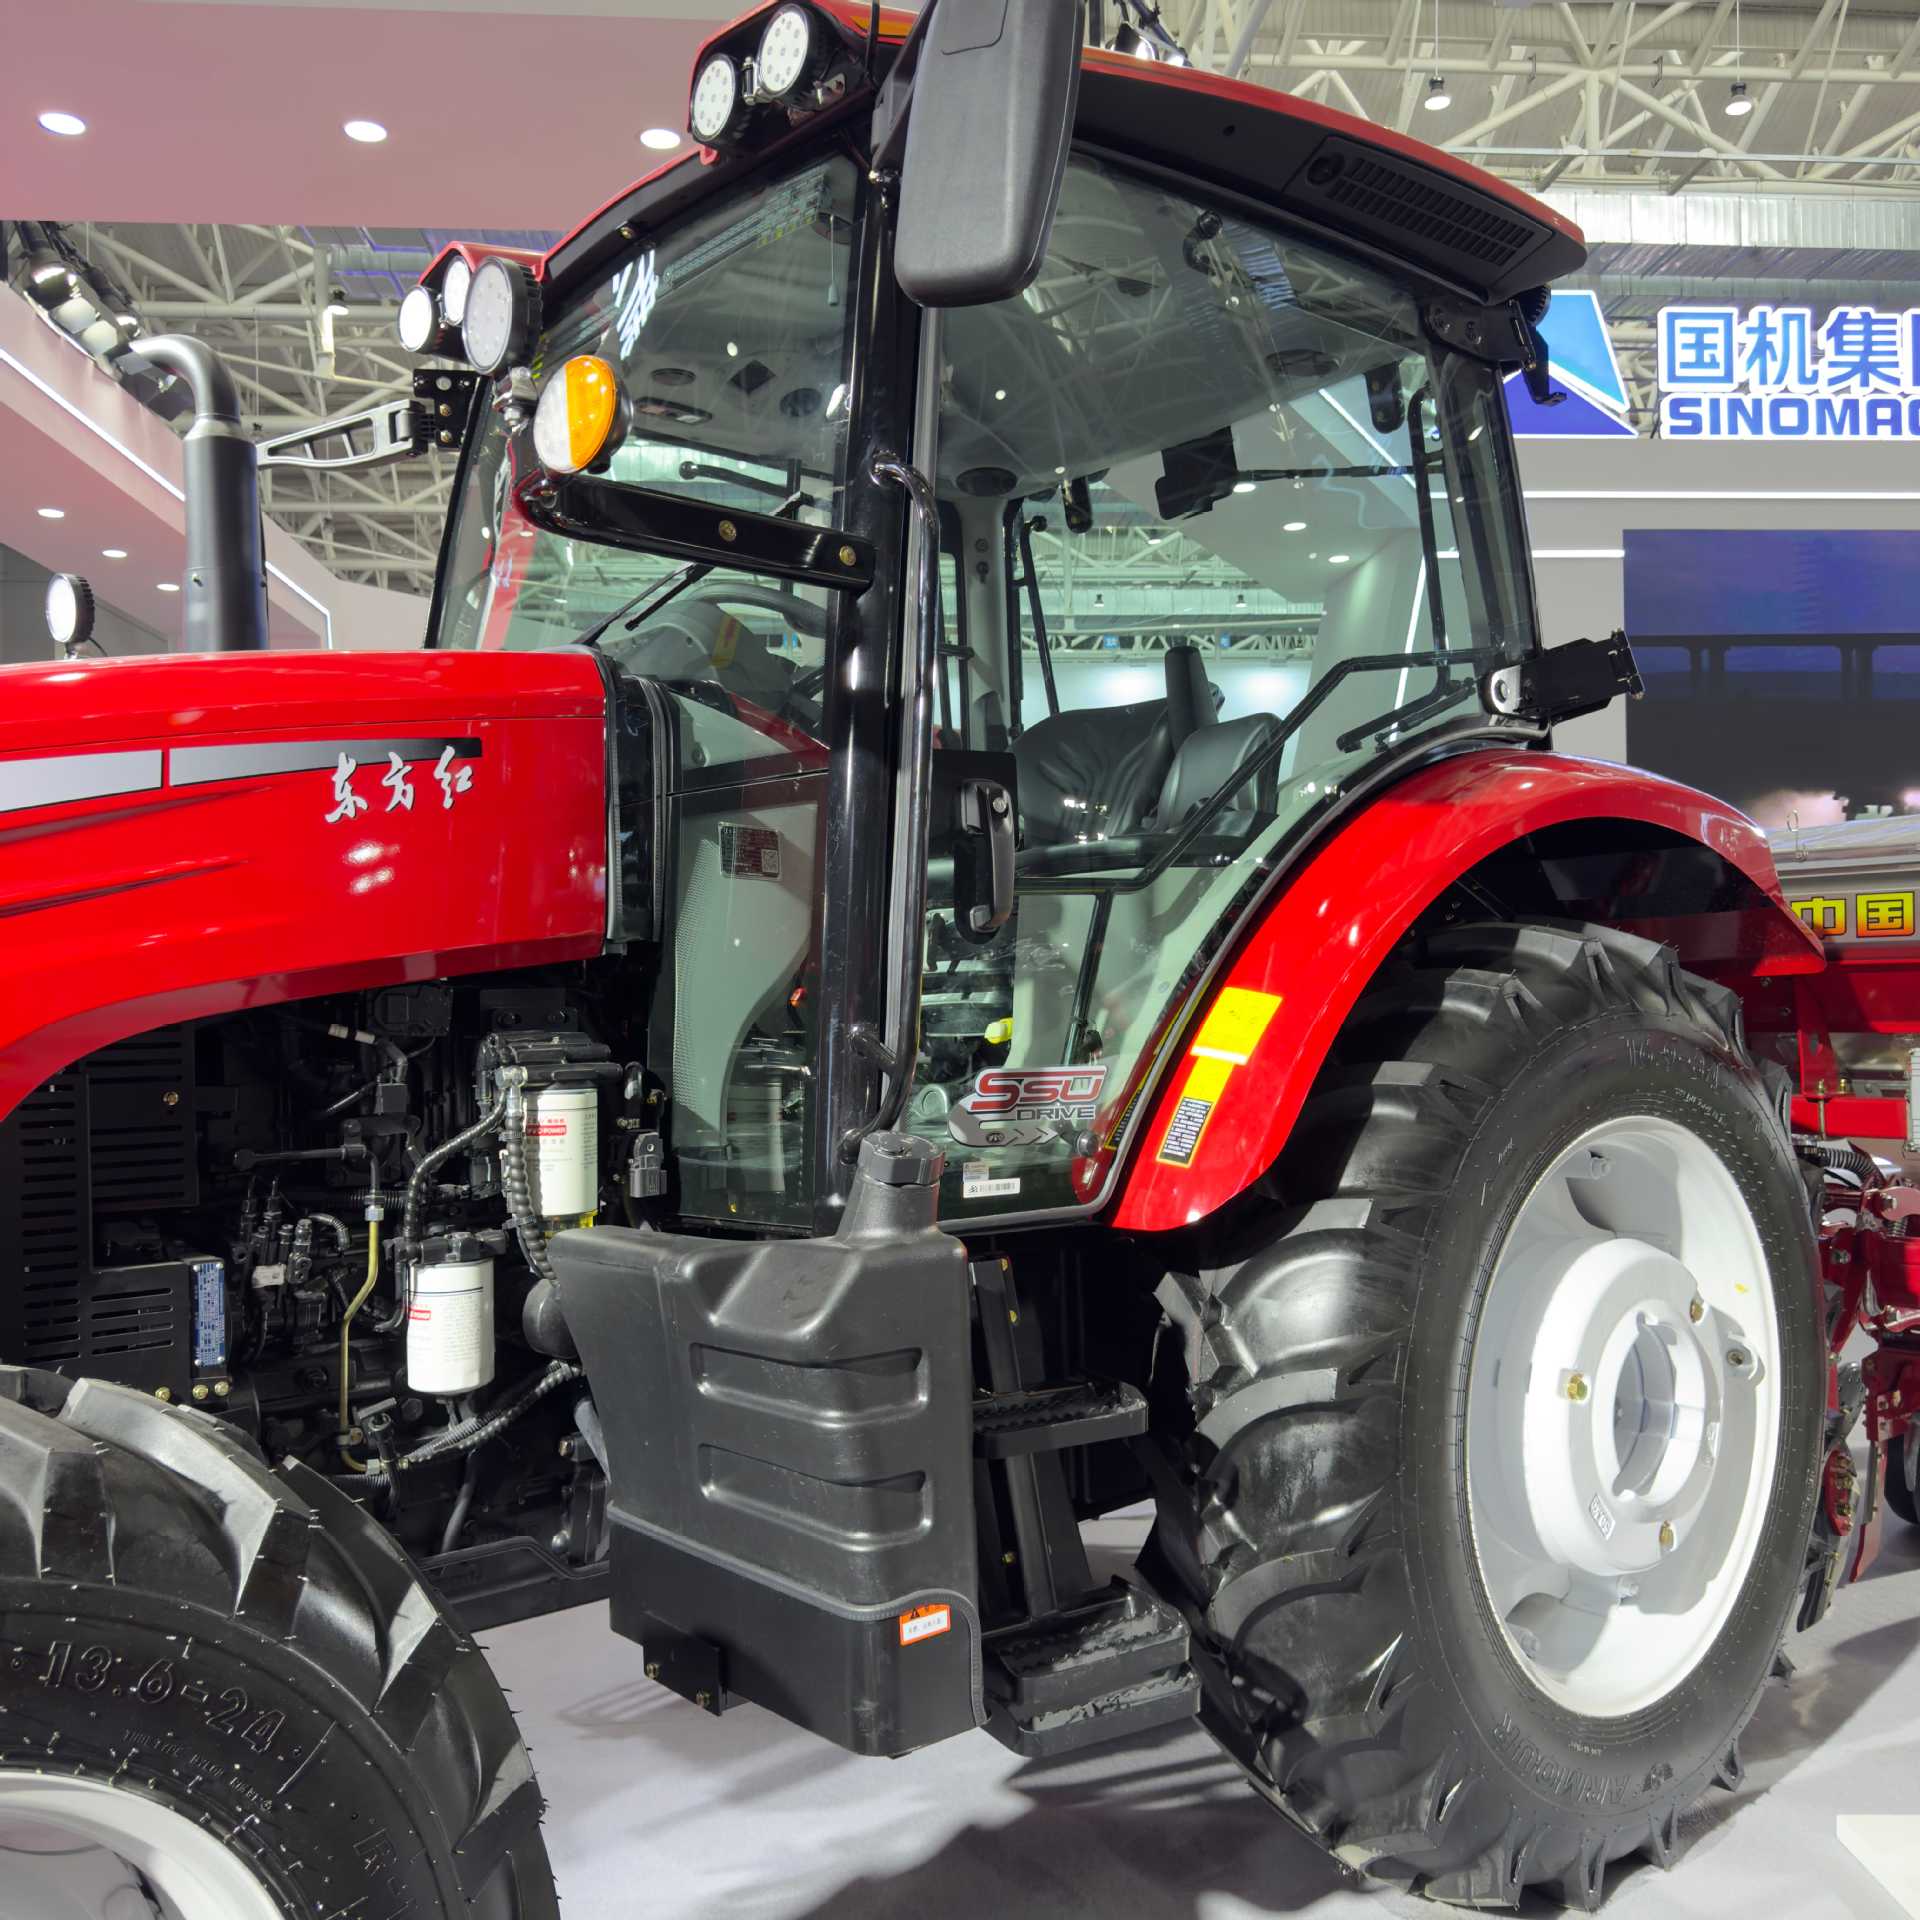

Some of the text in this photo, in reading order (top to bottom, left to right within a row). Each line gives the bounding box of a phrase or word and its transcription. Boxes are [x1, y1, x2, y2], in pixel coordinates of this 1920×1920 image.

[1664, 309, 1920, 388] 国机集
[325, 746, 473, 823] 东方红
[1791, 891, 1916, 939] 中国
[970, 1068, 1107, 1112] SSU
[1016, 1104, 1096, 1121] DRIVE
[38, 1640, 287, 1753] 13.6-24
